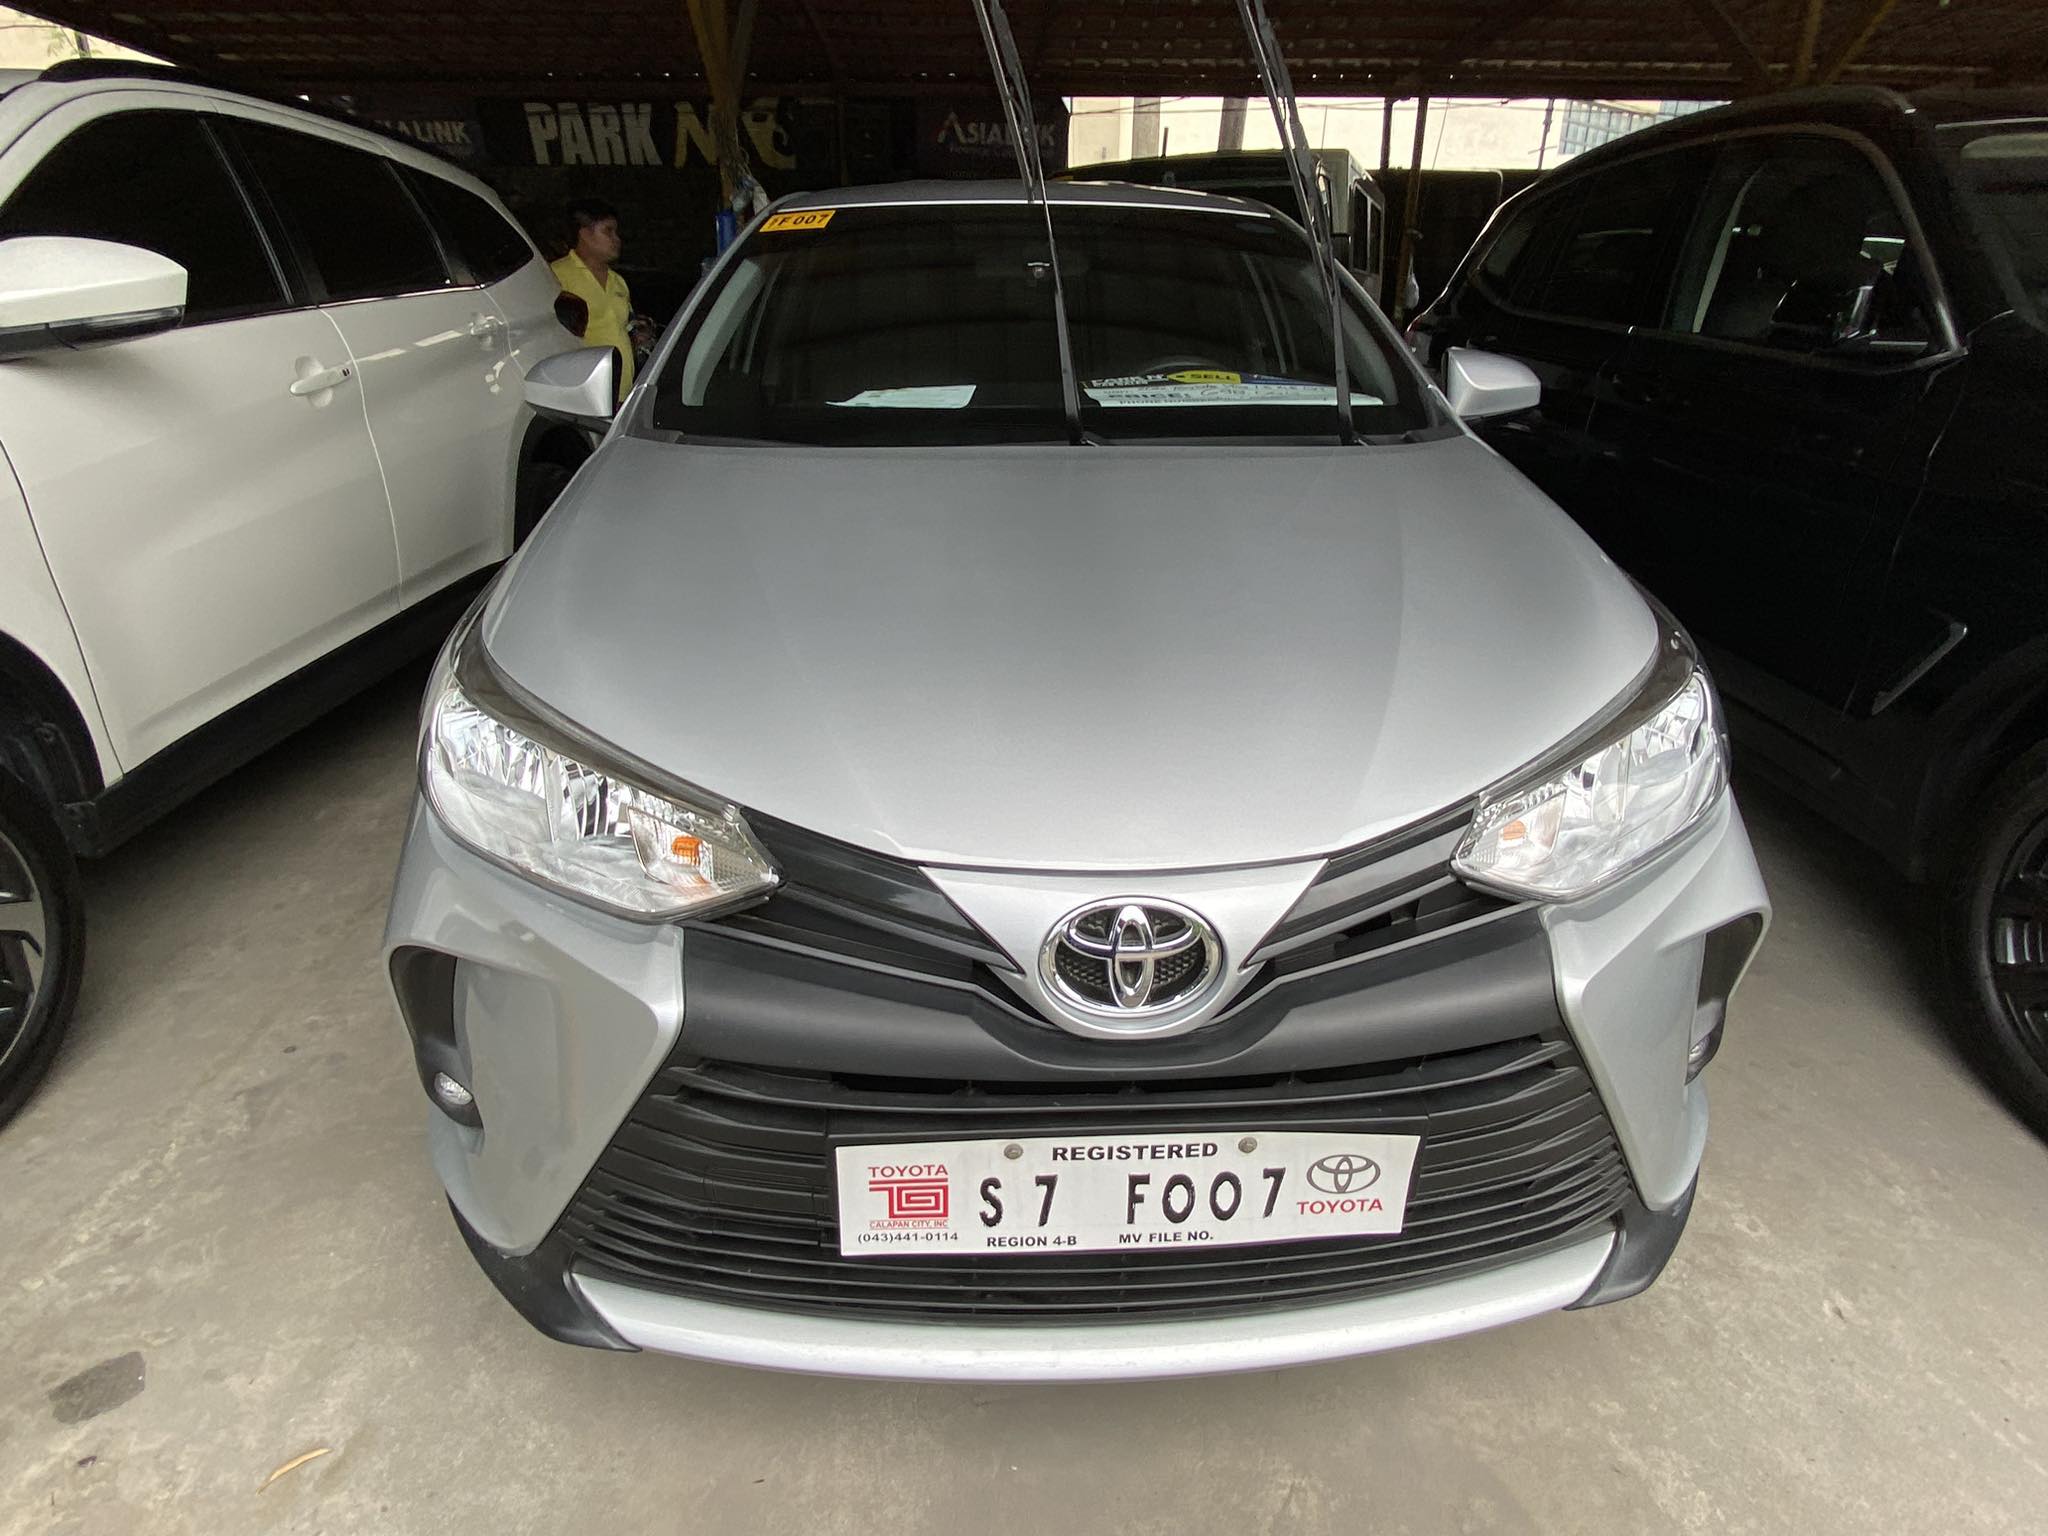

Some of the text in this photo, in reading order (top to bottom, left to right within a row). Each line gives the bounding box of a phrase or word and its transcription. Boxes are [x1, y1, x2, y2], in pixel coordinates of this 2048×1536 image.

[523, 102, 664, 166] PARK
[937, 112, 1056, 146] ASIALK
[1052, 1142, 1218, 1161] REGISTERED
[868, 1164, 948, 1178] TOYOTA
[1296, 1198, 1384, 1215] TOYOTA
[869, 1221, 909, 1230] CALAPAN
[857, 1232, 959, 1244] (043)441-0114
[986, 1236, 1077, 1247] REGION 4-B
[1119, 1230, 1214, 1243] MV FILE NO.
